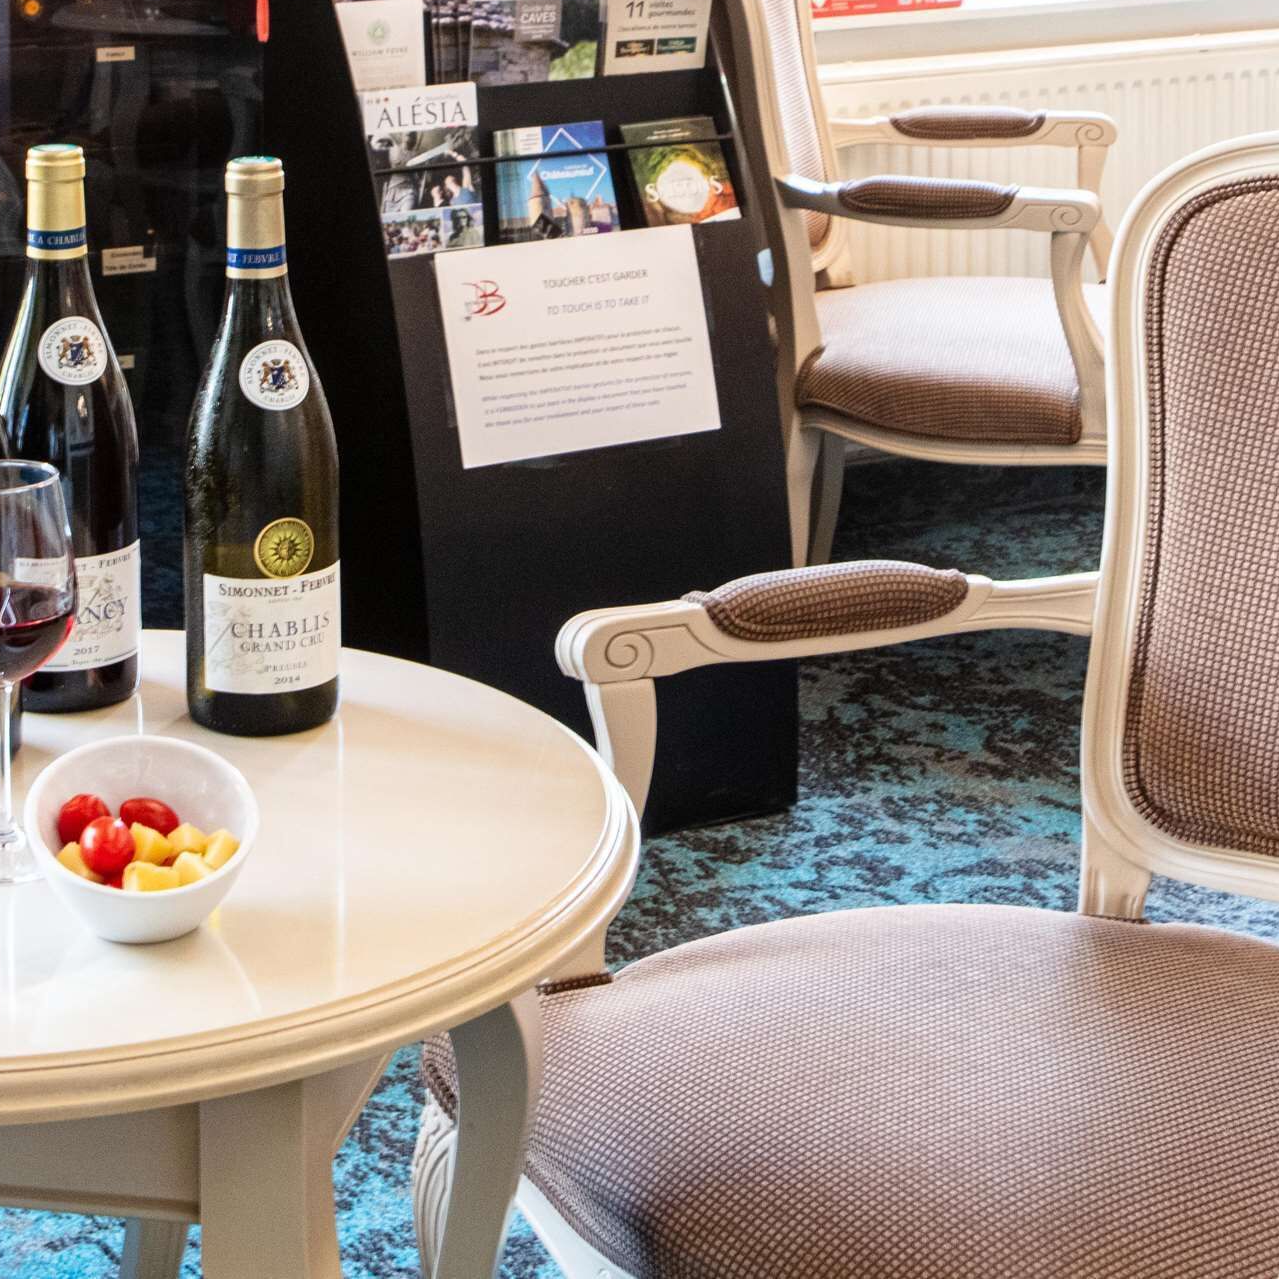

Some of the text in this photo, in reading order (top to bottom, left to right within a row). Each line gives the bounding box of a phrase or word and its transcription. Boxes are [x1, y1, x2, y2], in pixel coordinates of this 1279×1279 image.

[520, 11, 557, 24] CAVES
[625, 0, 645, 19] 11
[377, 97, 467, 129] ALÉSIA
[543, 275, 586, 289] TOUCHER
[612, 269, 648, 282] GARDER
[547, 304, 560, 316] TO
[561, 301, 593, 314] TOUCH
[605, 298, 617, 309] TO
[619, 295, 640, 307] TAKE
[218, 583, 290, 598] SIMONNET
[300, 572, 337, 594] FEBVRE
[231, 612, 331, 640] CHABLIS
[73, 645, 101, 656] 2017
[239, 632, 325, 653] GRAND CRU
